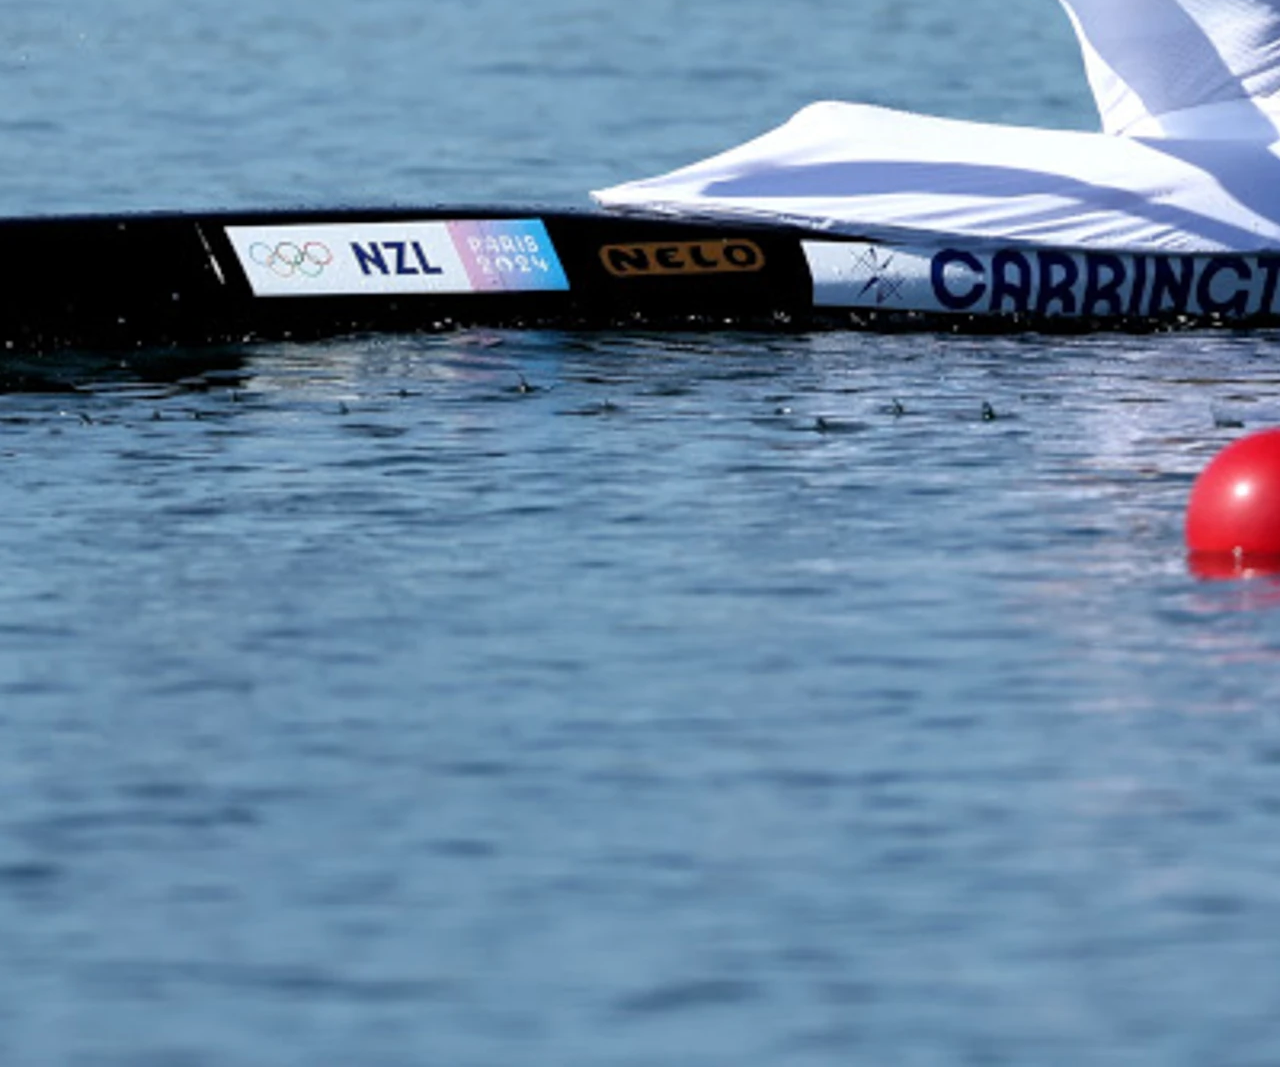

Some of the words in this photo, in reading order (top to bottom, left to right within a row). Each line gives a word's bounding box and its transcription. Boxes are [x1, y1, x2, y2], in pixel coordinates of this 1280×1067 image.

[467, 234, 539, 254] PARIS
[350, 241, 444, 275] NZL
[476, 255, 549, 275] 2024
[607, 244, 757, 272] NELO
